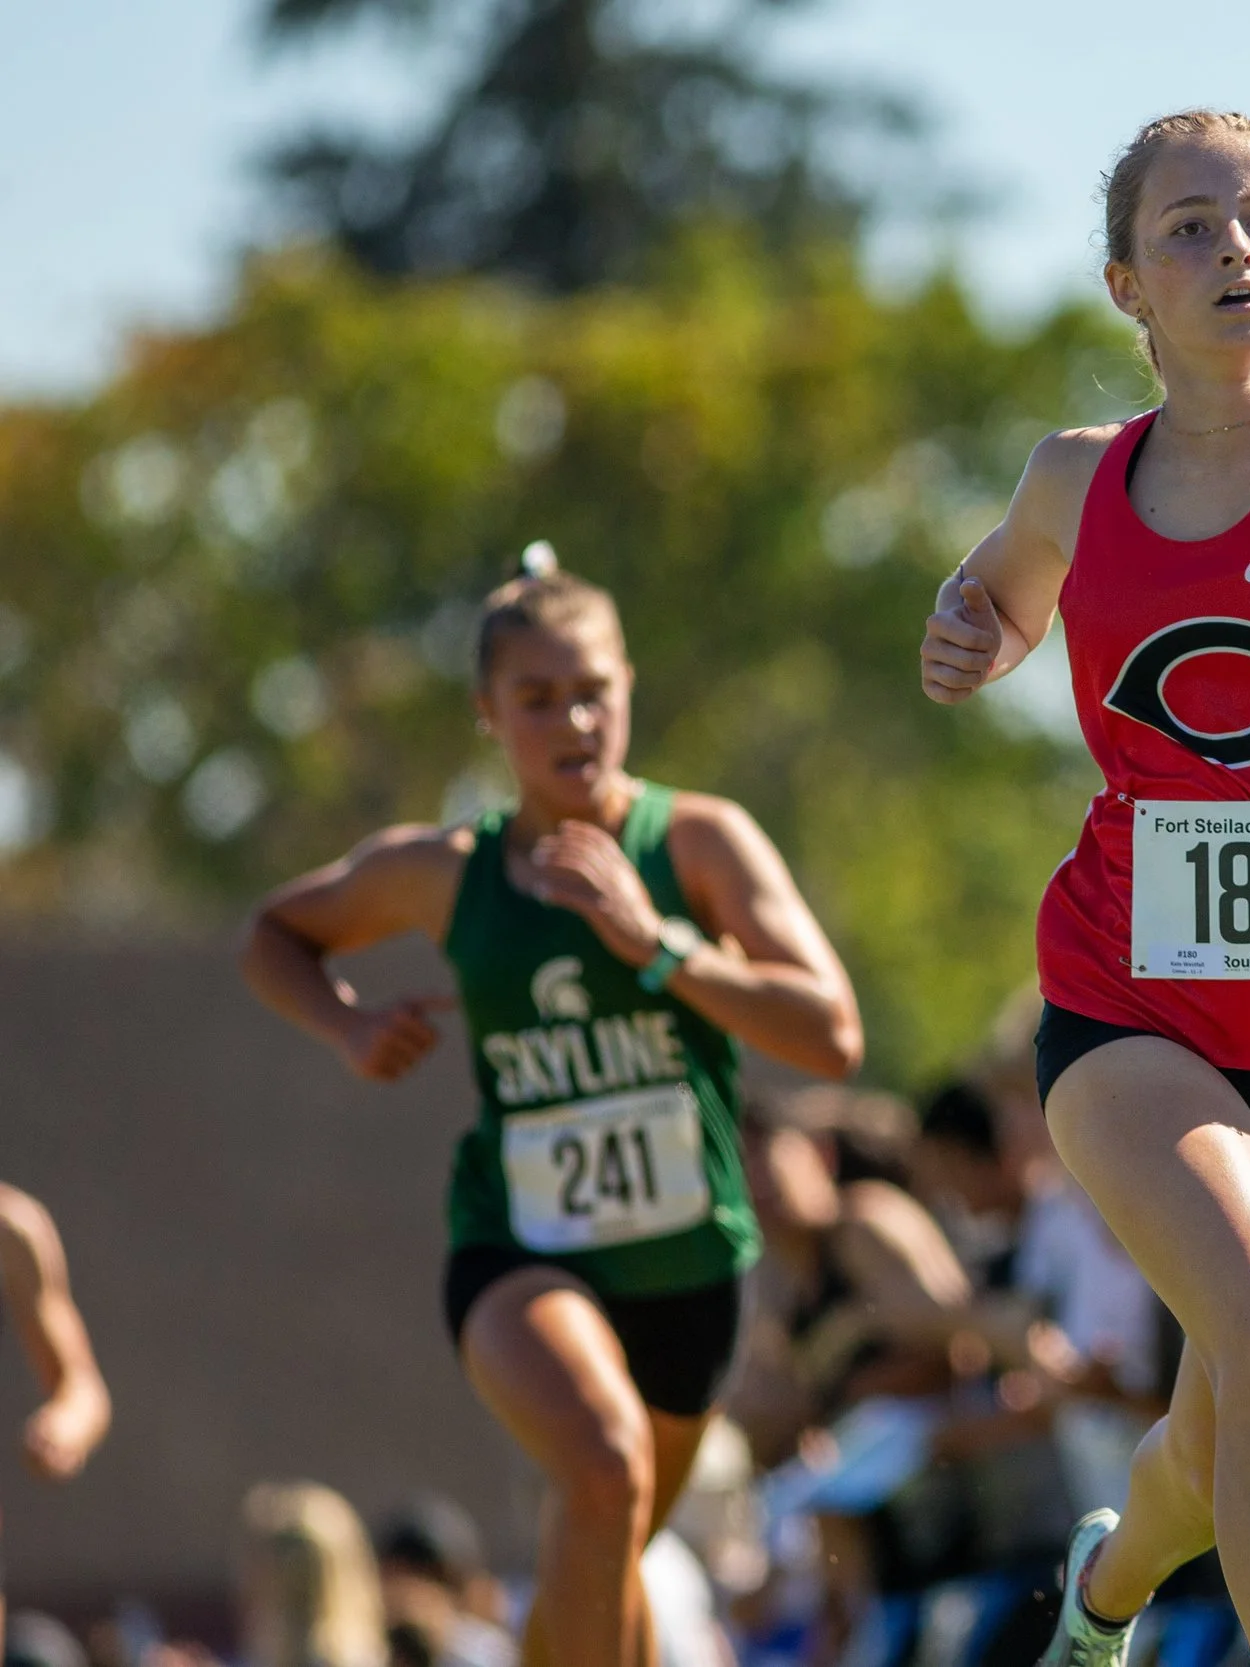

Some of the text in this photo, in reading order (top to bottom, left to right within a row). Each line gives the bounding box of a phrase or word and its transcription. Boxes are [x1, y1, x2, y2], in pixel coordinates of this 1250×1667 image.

[1154, 818, 1189, 834] Fort
[483, 1010, 687, 1105] SKYLINE
[551, 1128, 658, 1216] 241
